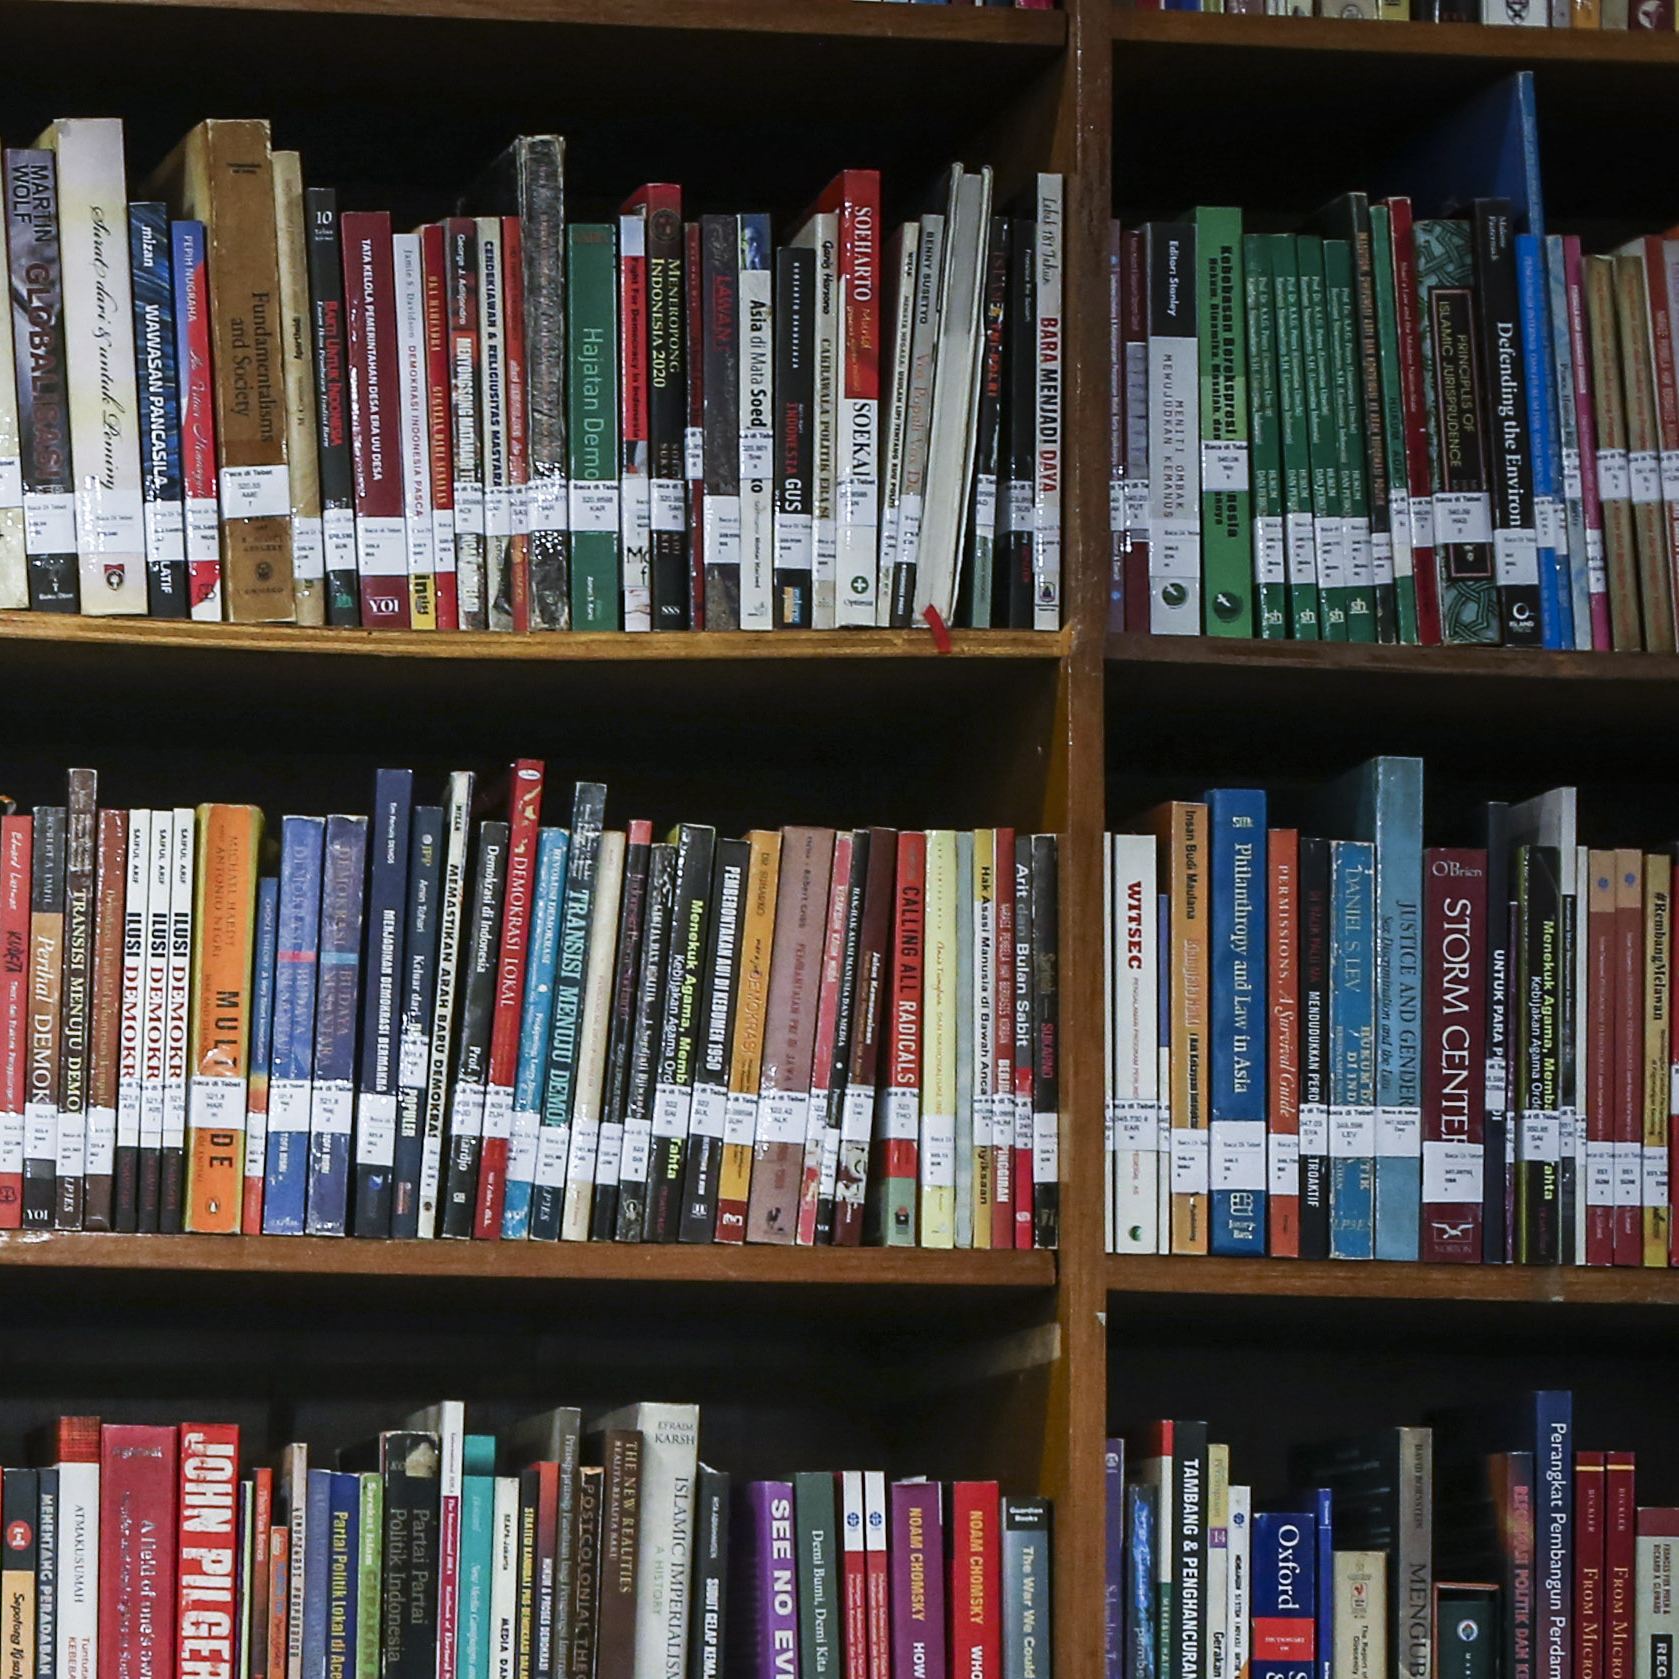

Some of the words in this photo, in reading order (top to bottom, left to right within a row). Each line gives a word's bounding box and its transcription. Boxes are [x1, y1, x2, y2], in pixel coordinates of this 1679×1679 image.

[12, 164, 31, 223] WOLF
[31, 164, 52, 242] MARTIN
[852, 206, 872, 301] SOEHARTO
[232, 318, 250, 351] and
[252, 291, 275, 442] Fundamentalisms
[1040, 317, 1058, 363] BARA
[230, 355, 253, 417] Society
[1040, 368, 1057, 444] MENJADI
[1039, 449, 1056, 492] DAYA
[505, 857, 527, 951] DEMOKRASI
[901, 886, 920, 957] CALLING
[1128, 881, 1143, 970] WITSEC
[1231, 843, 1252, 954] Philanthropy
[500, 957, 519, 1007] LOKAL
[900, 963, 918, 994] ALL
[1234, 960, 1251, 990] and
[898, 1000, 917, 1083] RADICALS
[1234, 995, 1252, 1029] Law
[1234, 1035, 1251, 1050] in
[1234, 1057, 1250, 1093] Asia
[183, 1432, 234, 1532] JOHN
[1547, 1422, 1567, 1506] Perangkat
[969, 1511, 984, 1552] NOAM
[1546, 1512, 1566, 1610] Pembangun
[969, 1556, 984, 1624] CHOMSKY
[1278, 1525, 1299, 1609] Oxford
